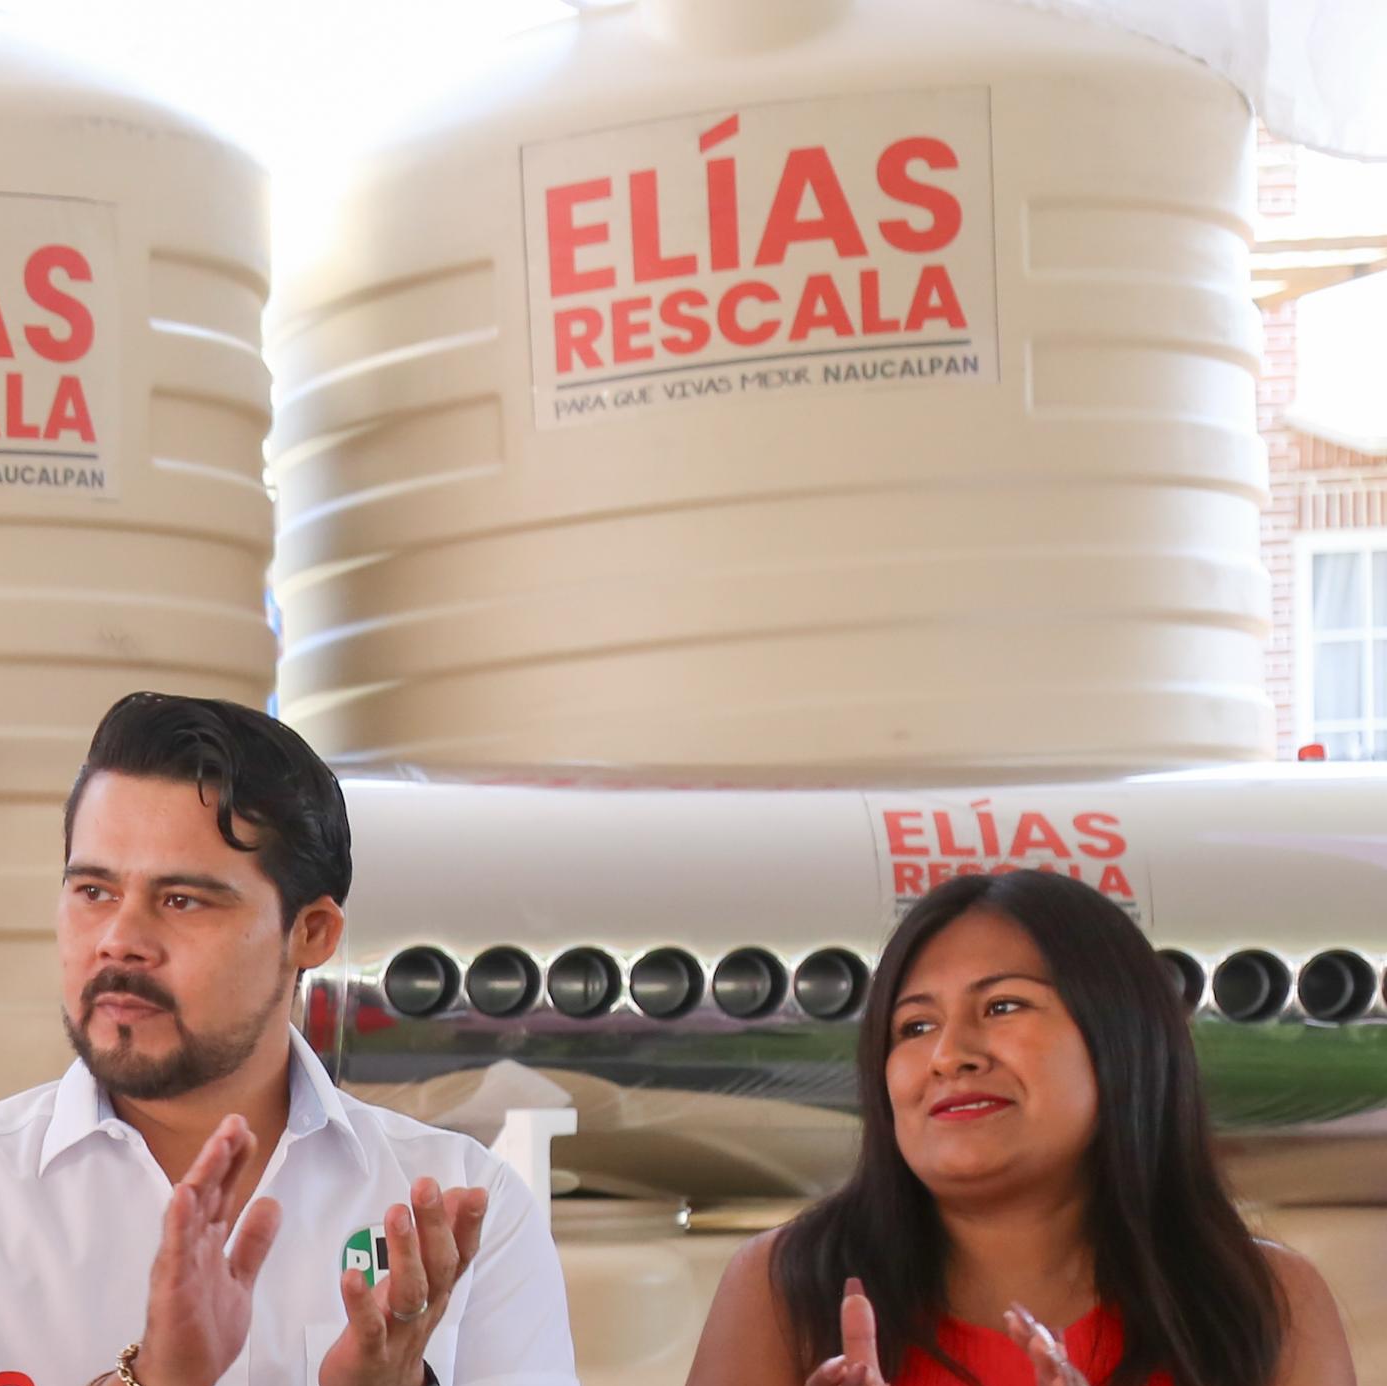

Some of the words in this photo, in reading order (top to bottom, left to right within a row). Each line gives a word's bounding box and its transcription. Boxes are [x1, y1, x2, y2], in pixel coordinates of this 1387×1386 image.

[545, 113, 963, 299] ELÍAS
[553, 265, 967, 375] RESCALA
[554, 395, 607, 420] PARA
[613, 387, 654, 409] QUE
[663, 376, 733, 401] VIVAS
[741, 367, 810, 391] MEJOR
[824, 355, 979, 385] NAUCALPAN
[882, 797, 1127, 859] ELÍAS
